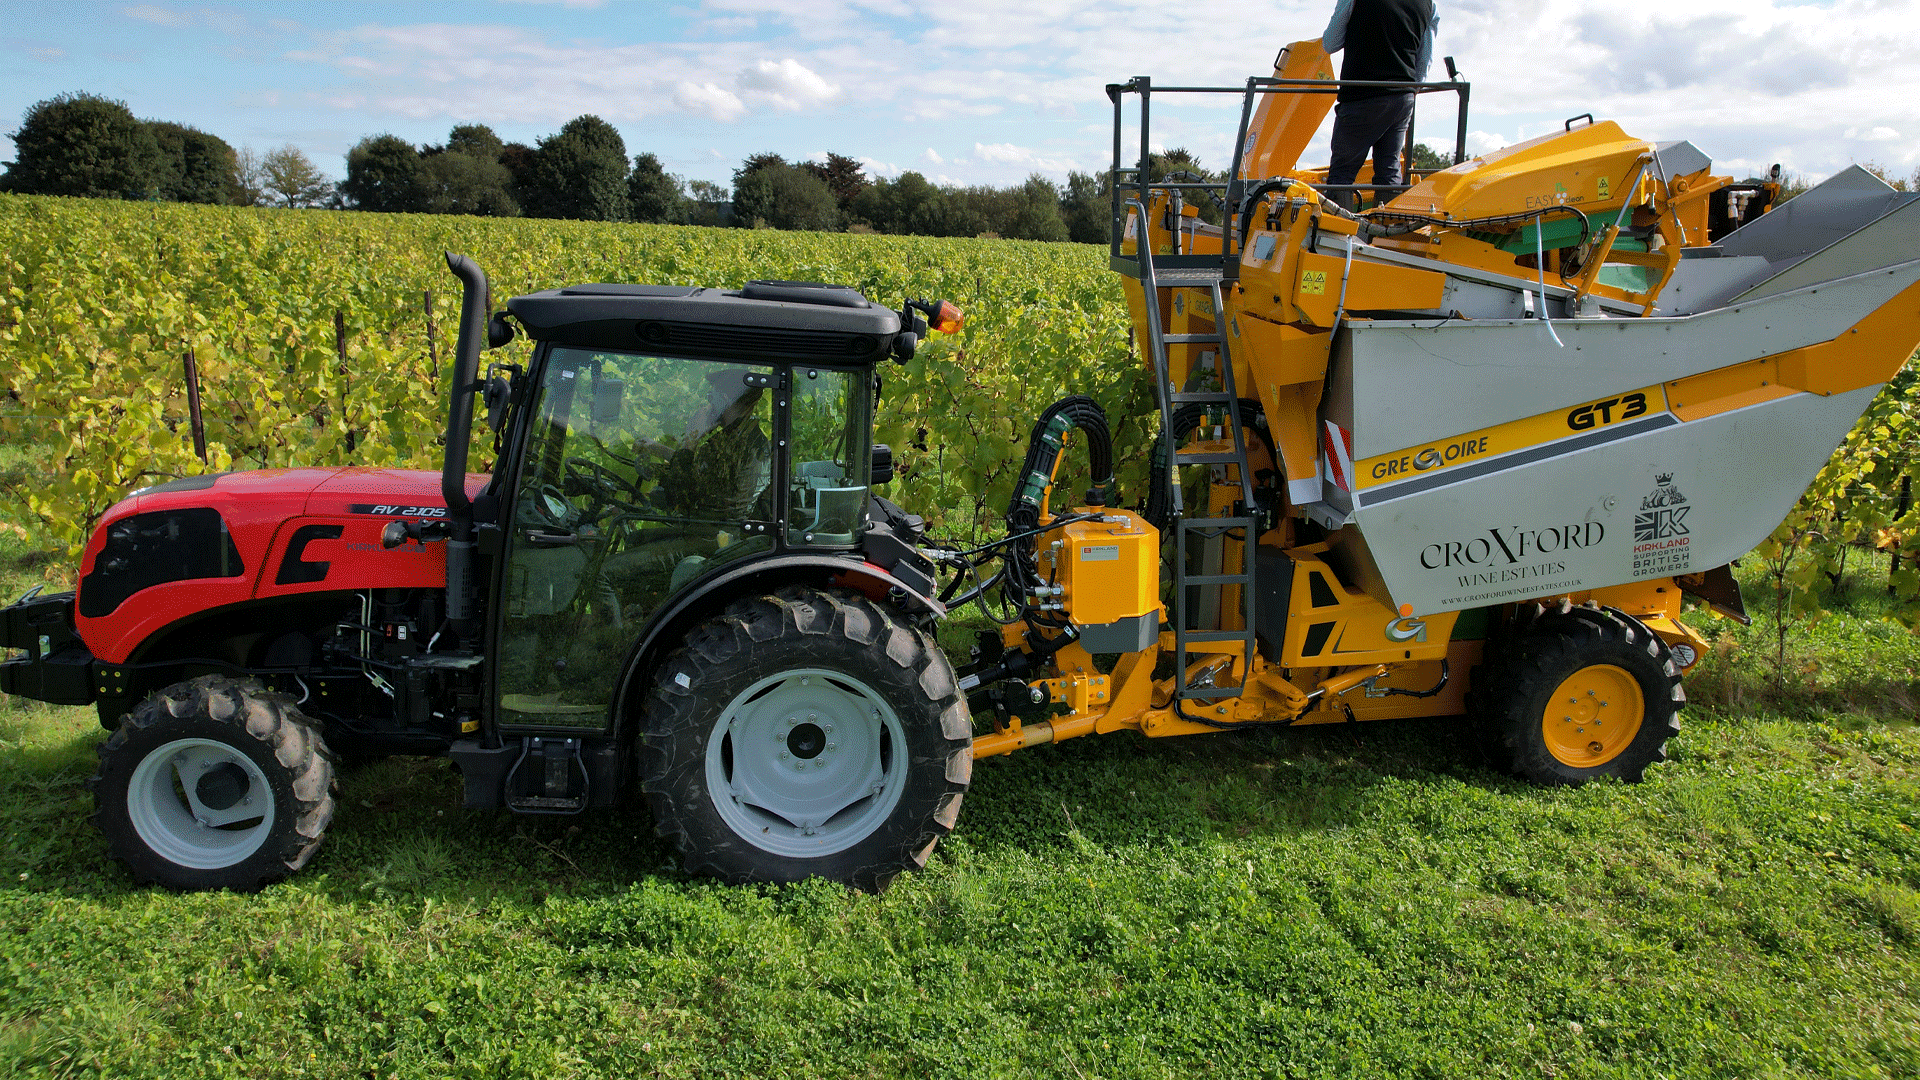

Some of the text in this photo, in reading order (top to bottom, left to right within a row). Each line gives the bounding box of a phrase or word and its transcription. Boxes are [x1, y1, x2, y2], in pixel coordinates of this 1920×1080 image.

[1526, 194, 1556, 209] EASY
[1567, 392, 1647, 431] GT3
[371, 505, 446, 517] AV 2.105
[1420, 521, 1605, 570] CROXFORD
[1633, 537, 1690, 553] KIRKLAND
[1633, 546, 1690, 560] SUPPORTING
[1632, 561, 1690, 577] GROWERS
[1633, 553, 1690, 569] BRITISH
[1457, 560, 1566, 588] WINE ESTATES
[1441, 578, 1582, 605] WWW.CROXFORDWINEESTATES.CO.UK
